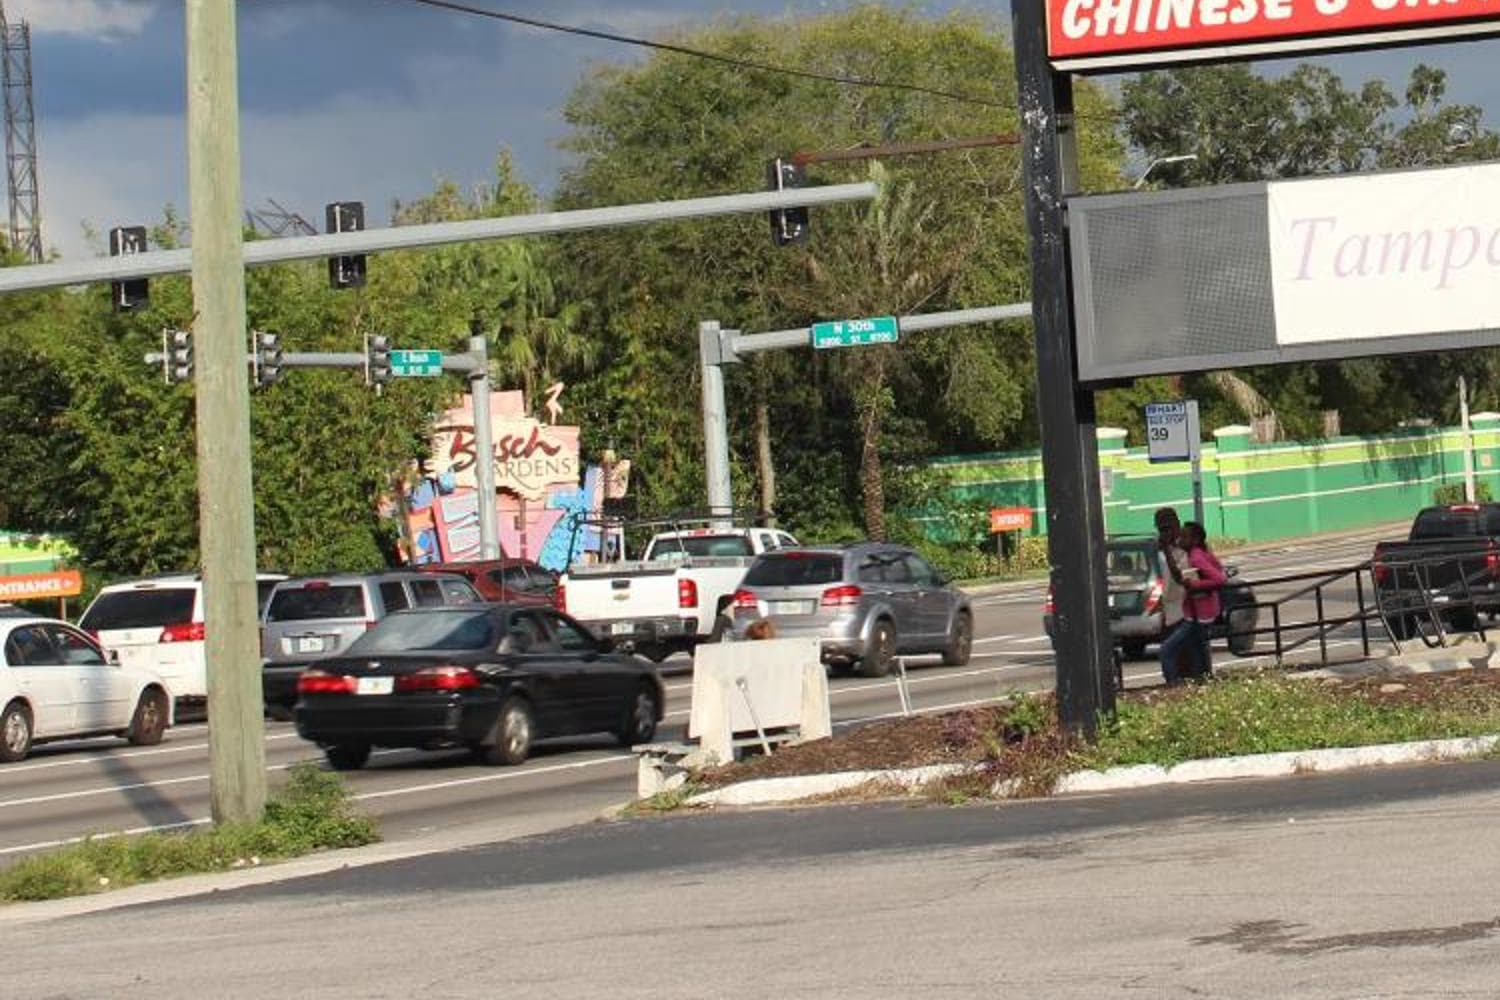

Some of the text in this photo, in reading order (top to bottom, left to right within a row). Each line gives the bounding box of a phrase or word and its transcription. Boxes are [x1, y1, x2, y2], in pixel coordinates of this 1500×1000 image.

[1151, 427, 1169, 440] 39
[449, 426, 561, 473] Bsch
[475, 458, 573, 486] ARDENS
[0, 579, 57, 596] NTRANCE
